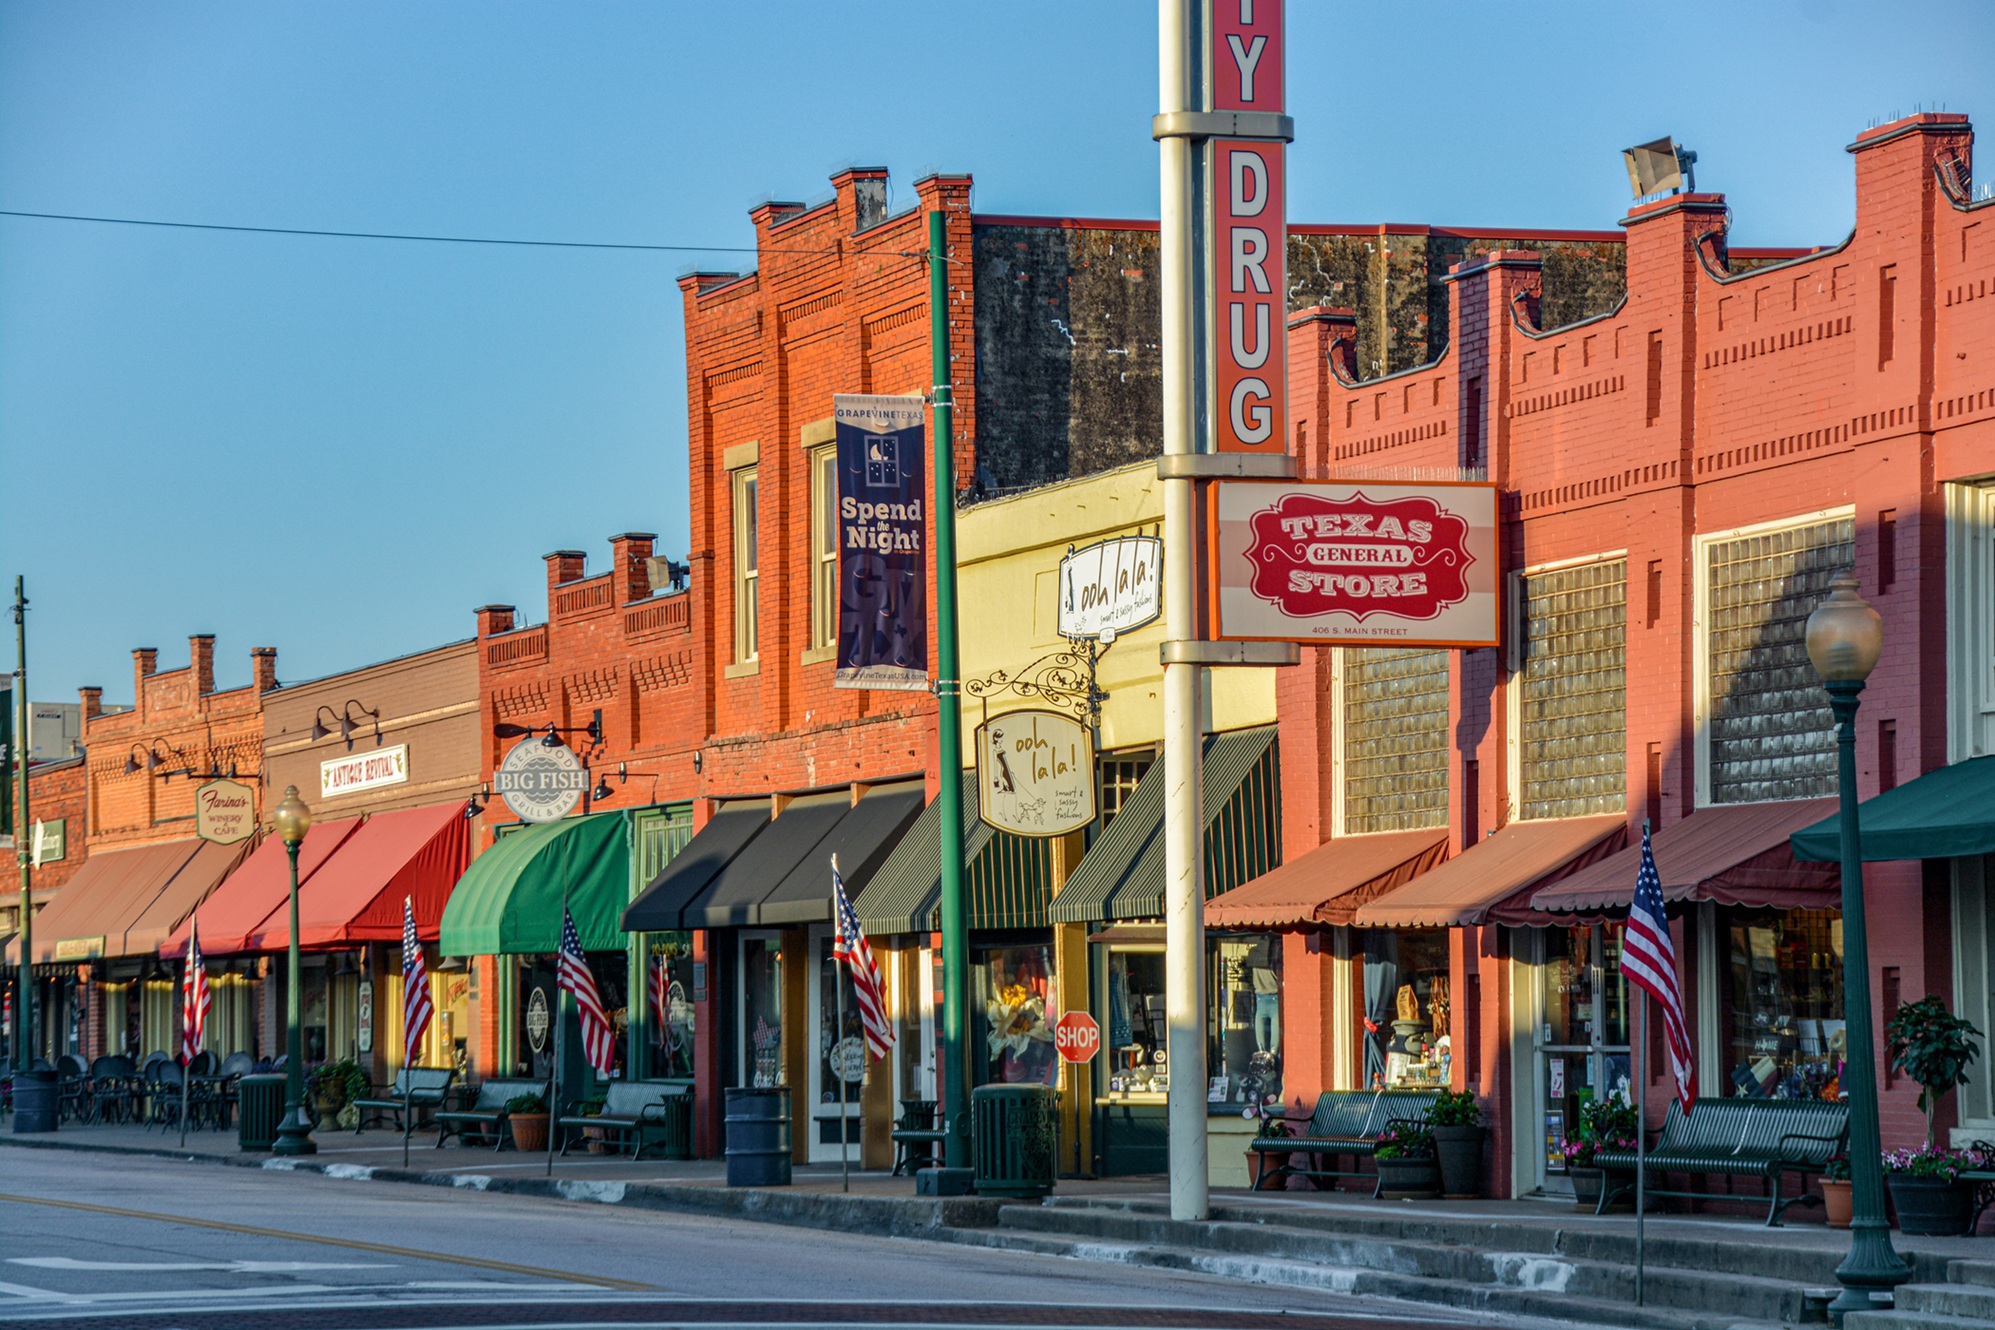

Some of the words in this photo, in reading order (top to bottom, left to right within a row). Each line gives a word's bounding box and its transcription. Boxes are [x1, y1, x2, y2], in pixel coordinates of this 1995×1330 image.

[1229, 150, 1273, 445] DRUG
[841, 496, 922, 525] Spend
[877, 521, 890, 532] the
[1280, 513, 1433, 544] TEXAS
[846, 526, 920, 555] Night
[1313, 546, 1408, 563] GENERAL
[1081, 538, 1109, 612] ooh
[1288, 569, 1428, 598] STORE
[1312, 626, 1330, 635] 406
[1332, 627, 1342, 635] S.
[1344, 627, 1369, 635] MAIN
[1371, 627, 1408, 636] STREET
[836, 671, 926, 681] GrapevineTexasUSA.com
[1015, 716, 1048, 753] ooh
[509, 744, 573, 770] SEAFOOD
[333, 761, 363, 788] ANTIQUE
[365, 755, 394, 781] REVIVAL
[500, 772, 535, 790] BIG
[539, 771, 585, 790] FISH
[201, 789, 249, 814] Farina's
[1055, 786, 1078, 798] smart
[511, 794, 542, 818] GRILL
[546, 808, 553, 817] &
[555, 792, 574, 813] BAR
[1055, 807, 1083, 821] fashions
[1059, 798, 1079, 811] sassy
[208, 814, 243, 824] WINERY
[213, 827, 239, 835] CAFE
[1056, 1028, 1100, 1048] SHOP
